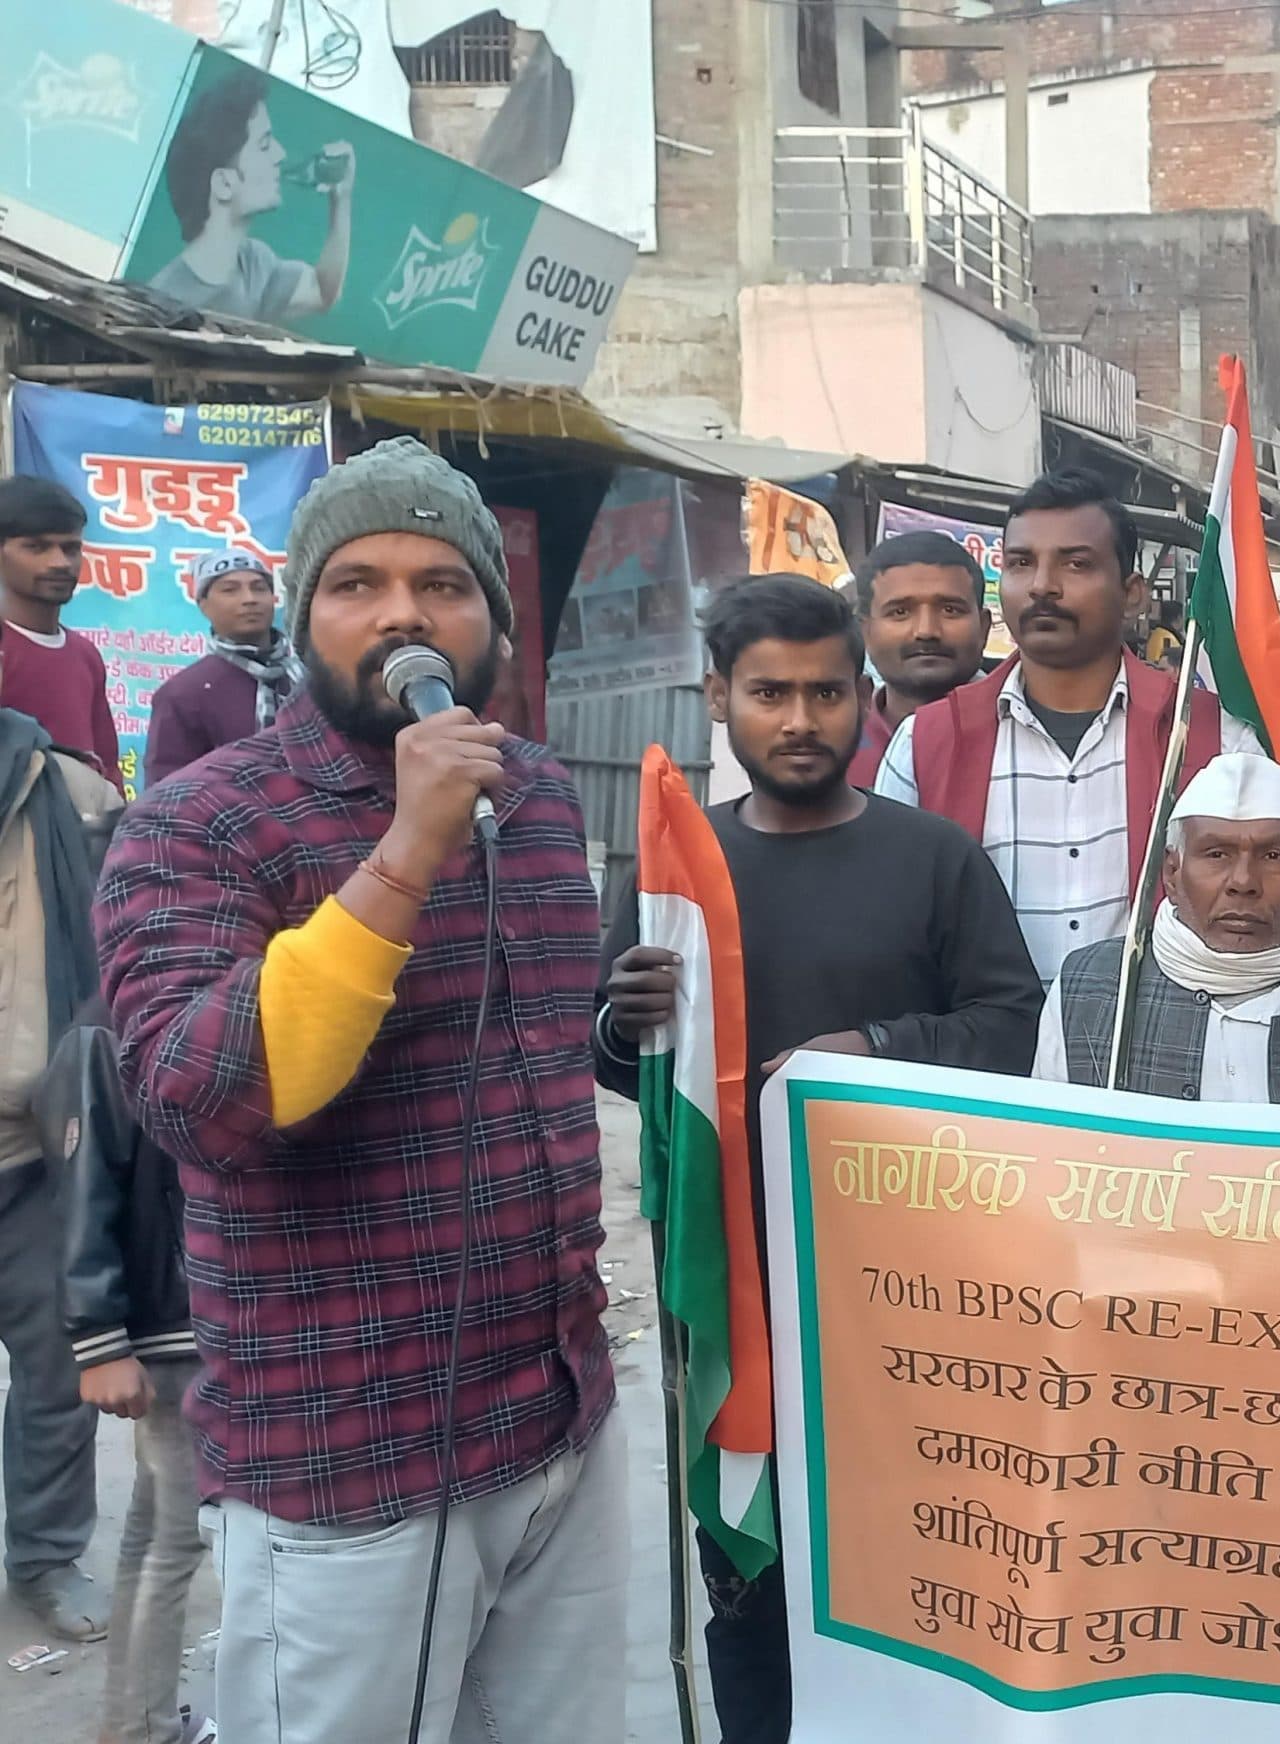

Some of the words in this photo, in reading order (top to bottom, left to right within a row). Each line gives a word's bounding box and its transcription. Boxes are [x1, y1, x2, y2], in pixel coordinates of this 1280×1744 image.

[386, 240, 484, 312] Sprite
[525, 256, 614, 316] GUDDU
[516, 312, 585, 362] CAKE
[830, 1125, 1038, 1216] नागरिक
[1046, 1145, 1195, 1233] संघर्ष
[861, 1266, 943, 1312] 70th
[955, 1279, 1085, 1330] BPSC
[881, 1344, 1032, 1402] सरकार
[1038, 1356, 1098, 1411] के
[914, 1425, 1126, 1491] दमनकारी
[1138, 1444, 1274, 1502] नीति
[912, 1495, 1068, 1589] शांतिपूर्ण
[910, 1575, 980, 1634] युवा
[985, 1593, 1074, 1655] सोच
[1085, 1605, 1189, 1664] युवा
